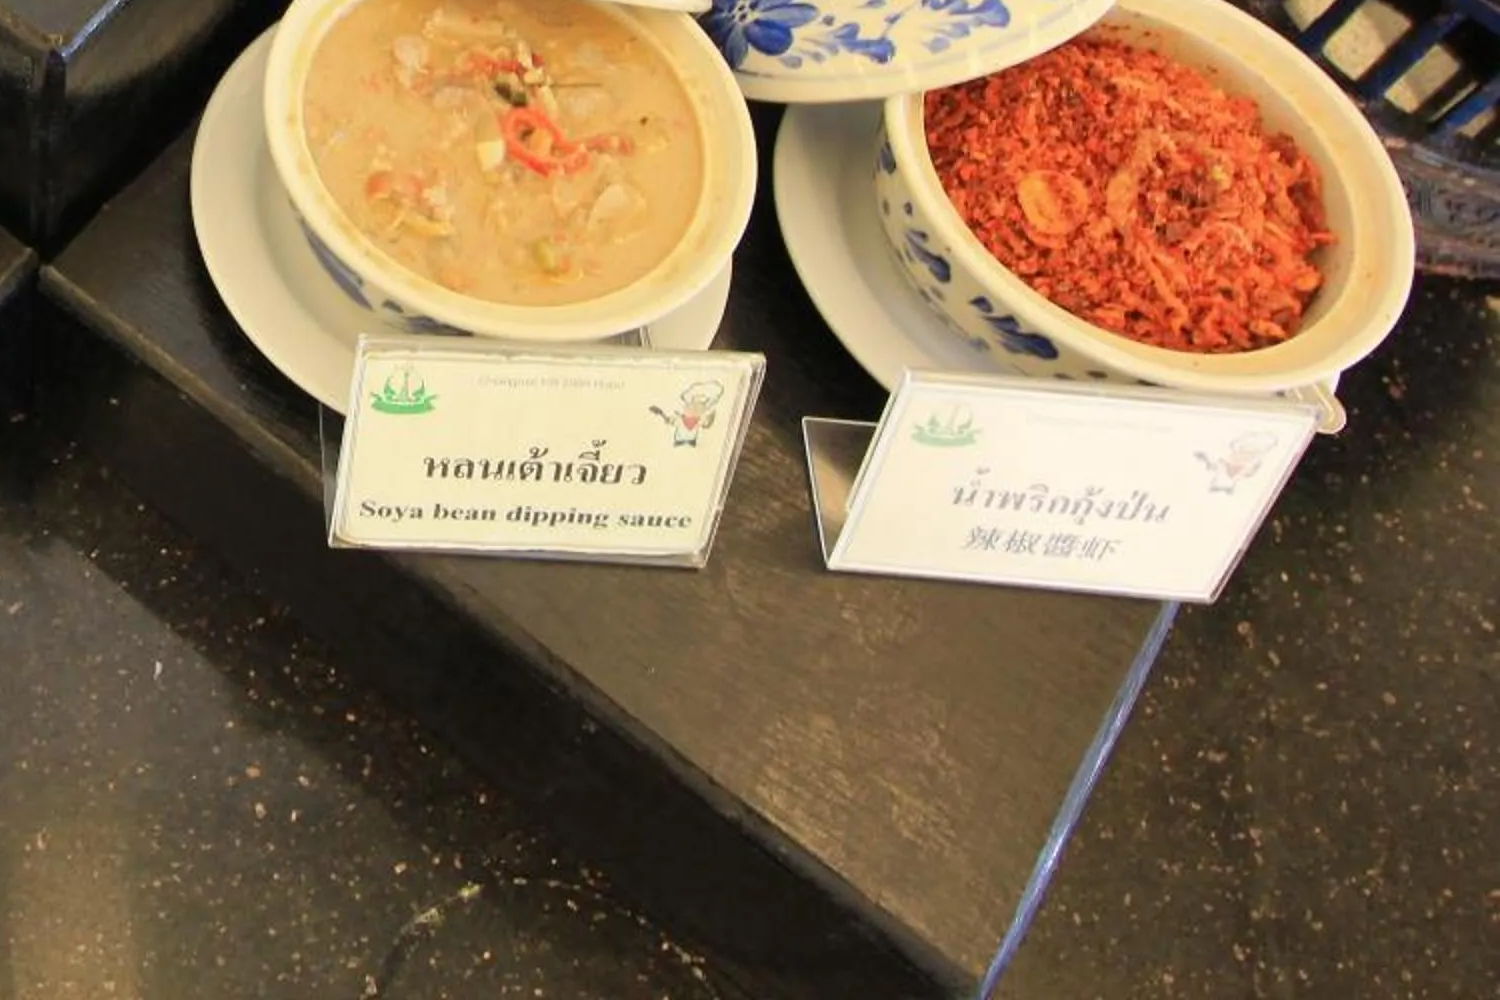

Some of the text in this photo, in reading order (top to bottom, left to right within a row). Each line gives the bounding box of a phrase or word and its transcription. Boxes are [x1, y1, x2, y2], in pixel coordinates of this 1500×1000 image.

[423, 438, 648, 486] หลนเต้าเจี้ยว
[359, 500, 693, 530] Soya bean dipping sauce
